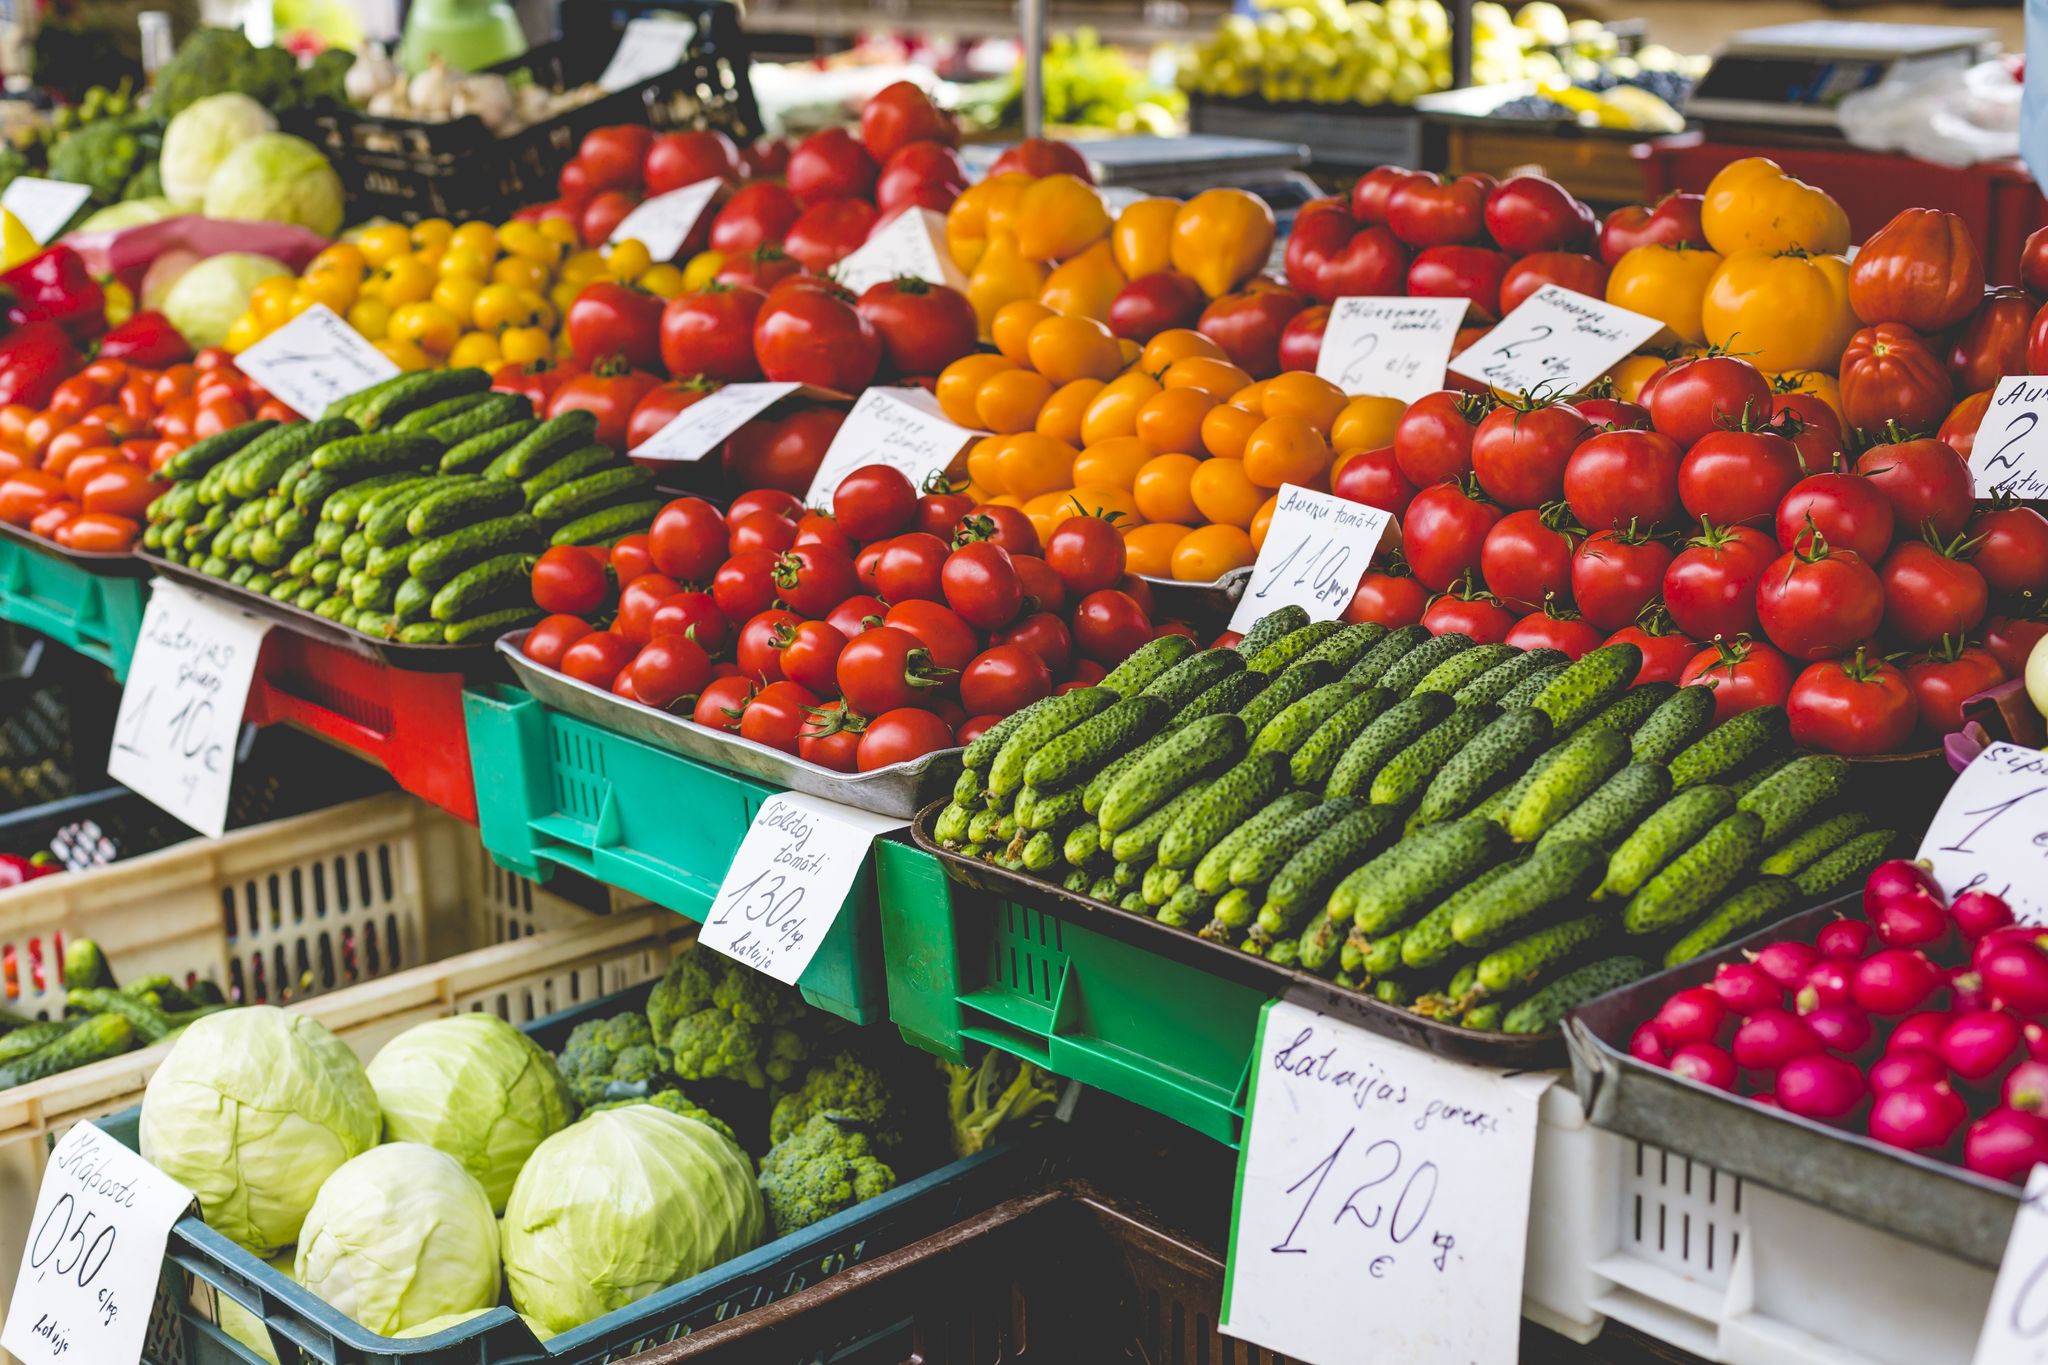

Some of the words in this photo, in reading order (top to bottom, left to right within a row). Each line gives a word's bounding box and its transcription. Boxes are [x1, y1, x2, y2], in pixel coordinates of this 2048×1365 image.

[1340, 333, 1378, 384] 2
[1493, 325, 1553, 359] 2
[1984, 412, 2038, 471] 2
[1334, 504, 1383, 530] tomāti
[1256, 534, 1350, 598] 110
[758, 801, 819, 852] Tolstoj
[1939, 787, 2047, 853] 1
[774, 843, 830, 876] tomāti
[713, 869, 805, 928] 130
[729, 931, 774, 969] Latvija
[1274, 1027, 1407, 1109] Latvijas
[59, 1133, 149, 1208] Kāposti
[1271, 1127, 1439, 1253] 120
[31, 1193, 116, 1288] 0,50
[1369, 1255, 1395, 1278] €
